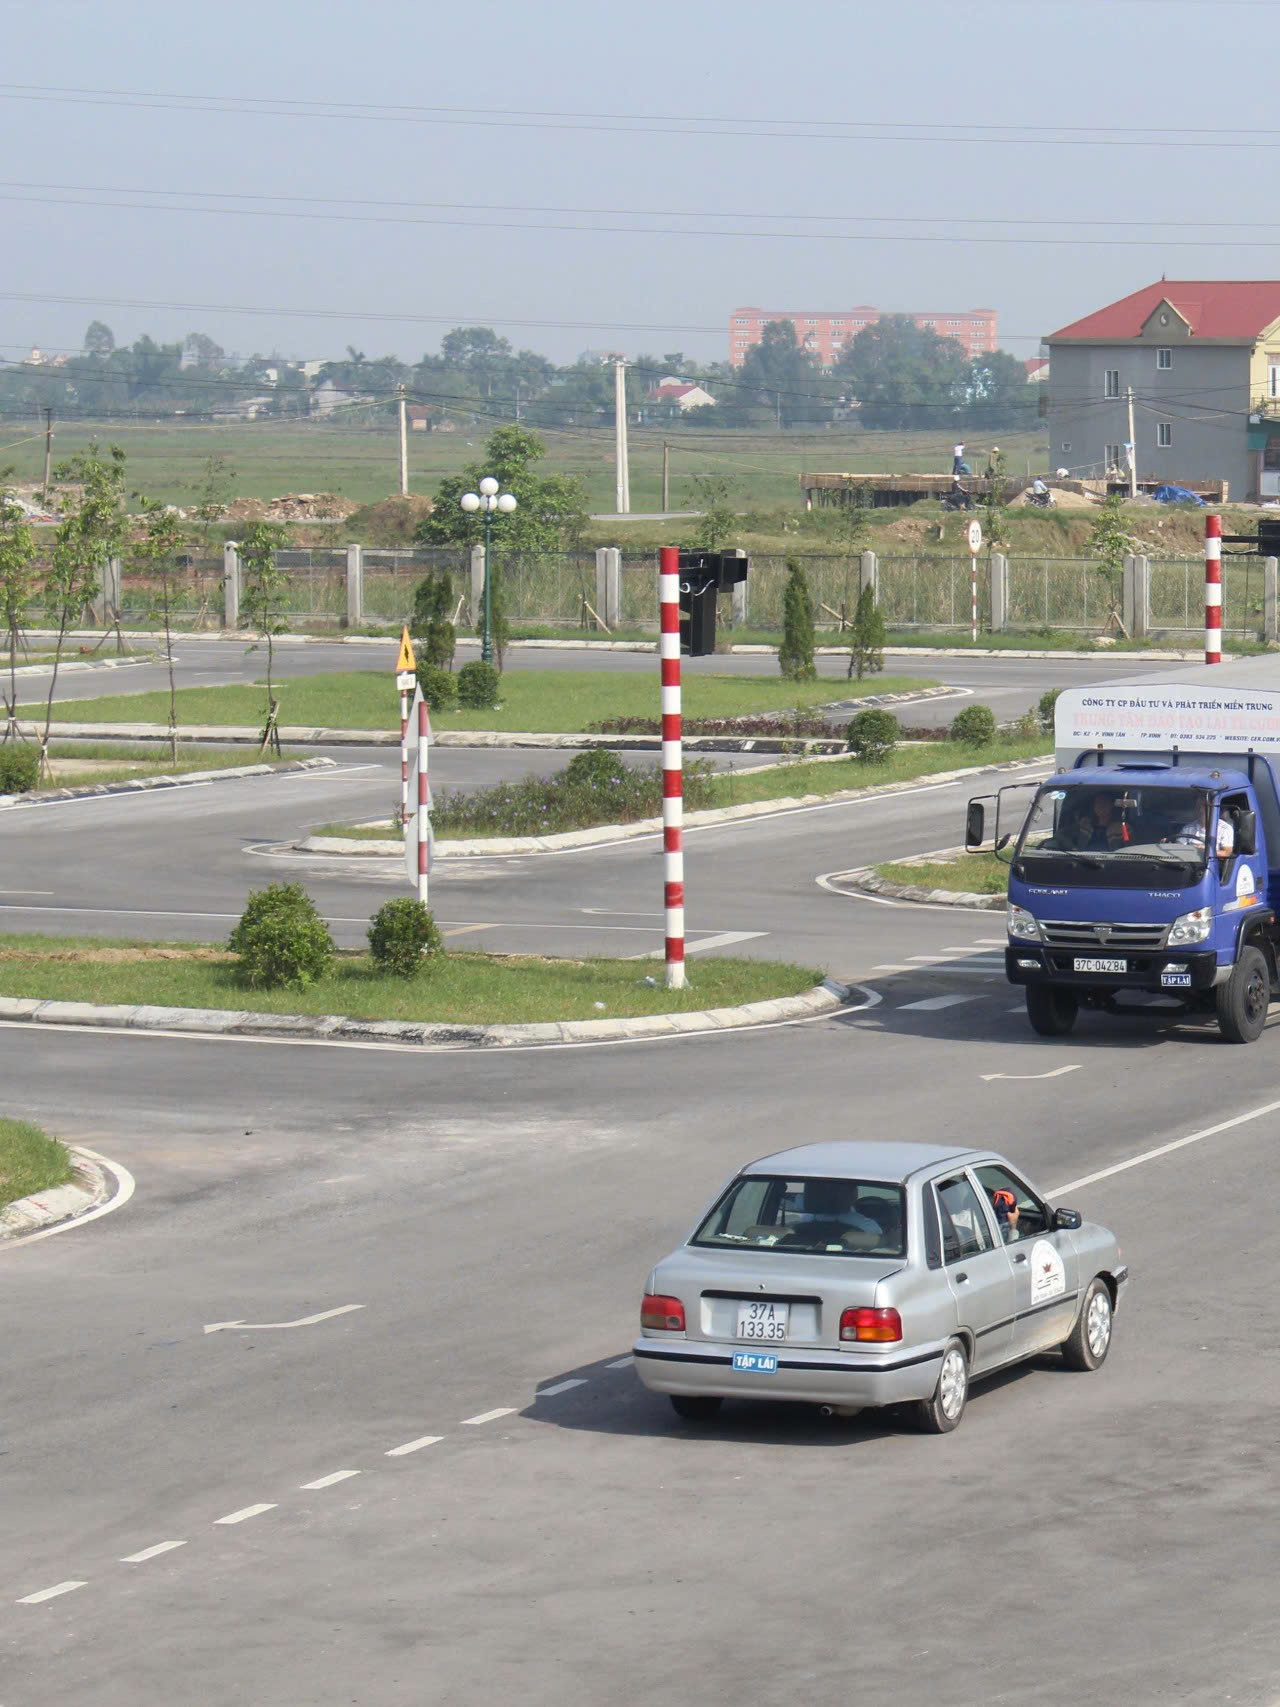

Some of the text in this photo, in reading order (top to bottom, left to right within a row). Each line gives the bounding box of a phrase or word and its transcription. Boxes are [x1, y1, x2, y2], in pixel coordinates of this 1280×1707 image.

[971, 529, 980, 544] 20
[1082, 697, 1104, 706] CÔNG
[1106, 699, 1116, 707] TY
[1161, 699, 1173, 708] VÀ
[1245, 703, 1273, 711] TRUNG
[749, 1303, 775, 1320] 37A
[740, 1321, 785, 1339] 133.35
[736, 1355, 774, 1369] TẬP LÁI
